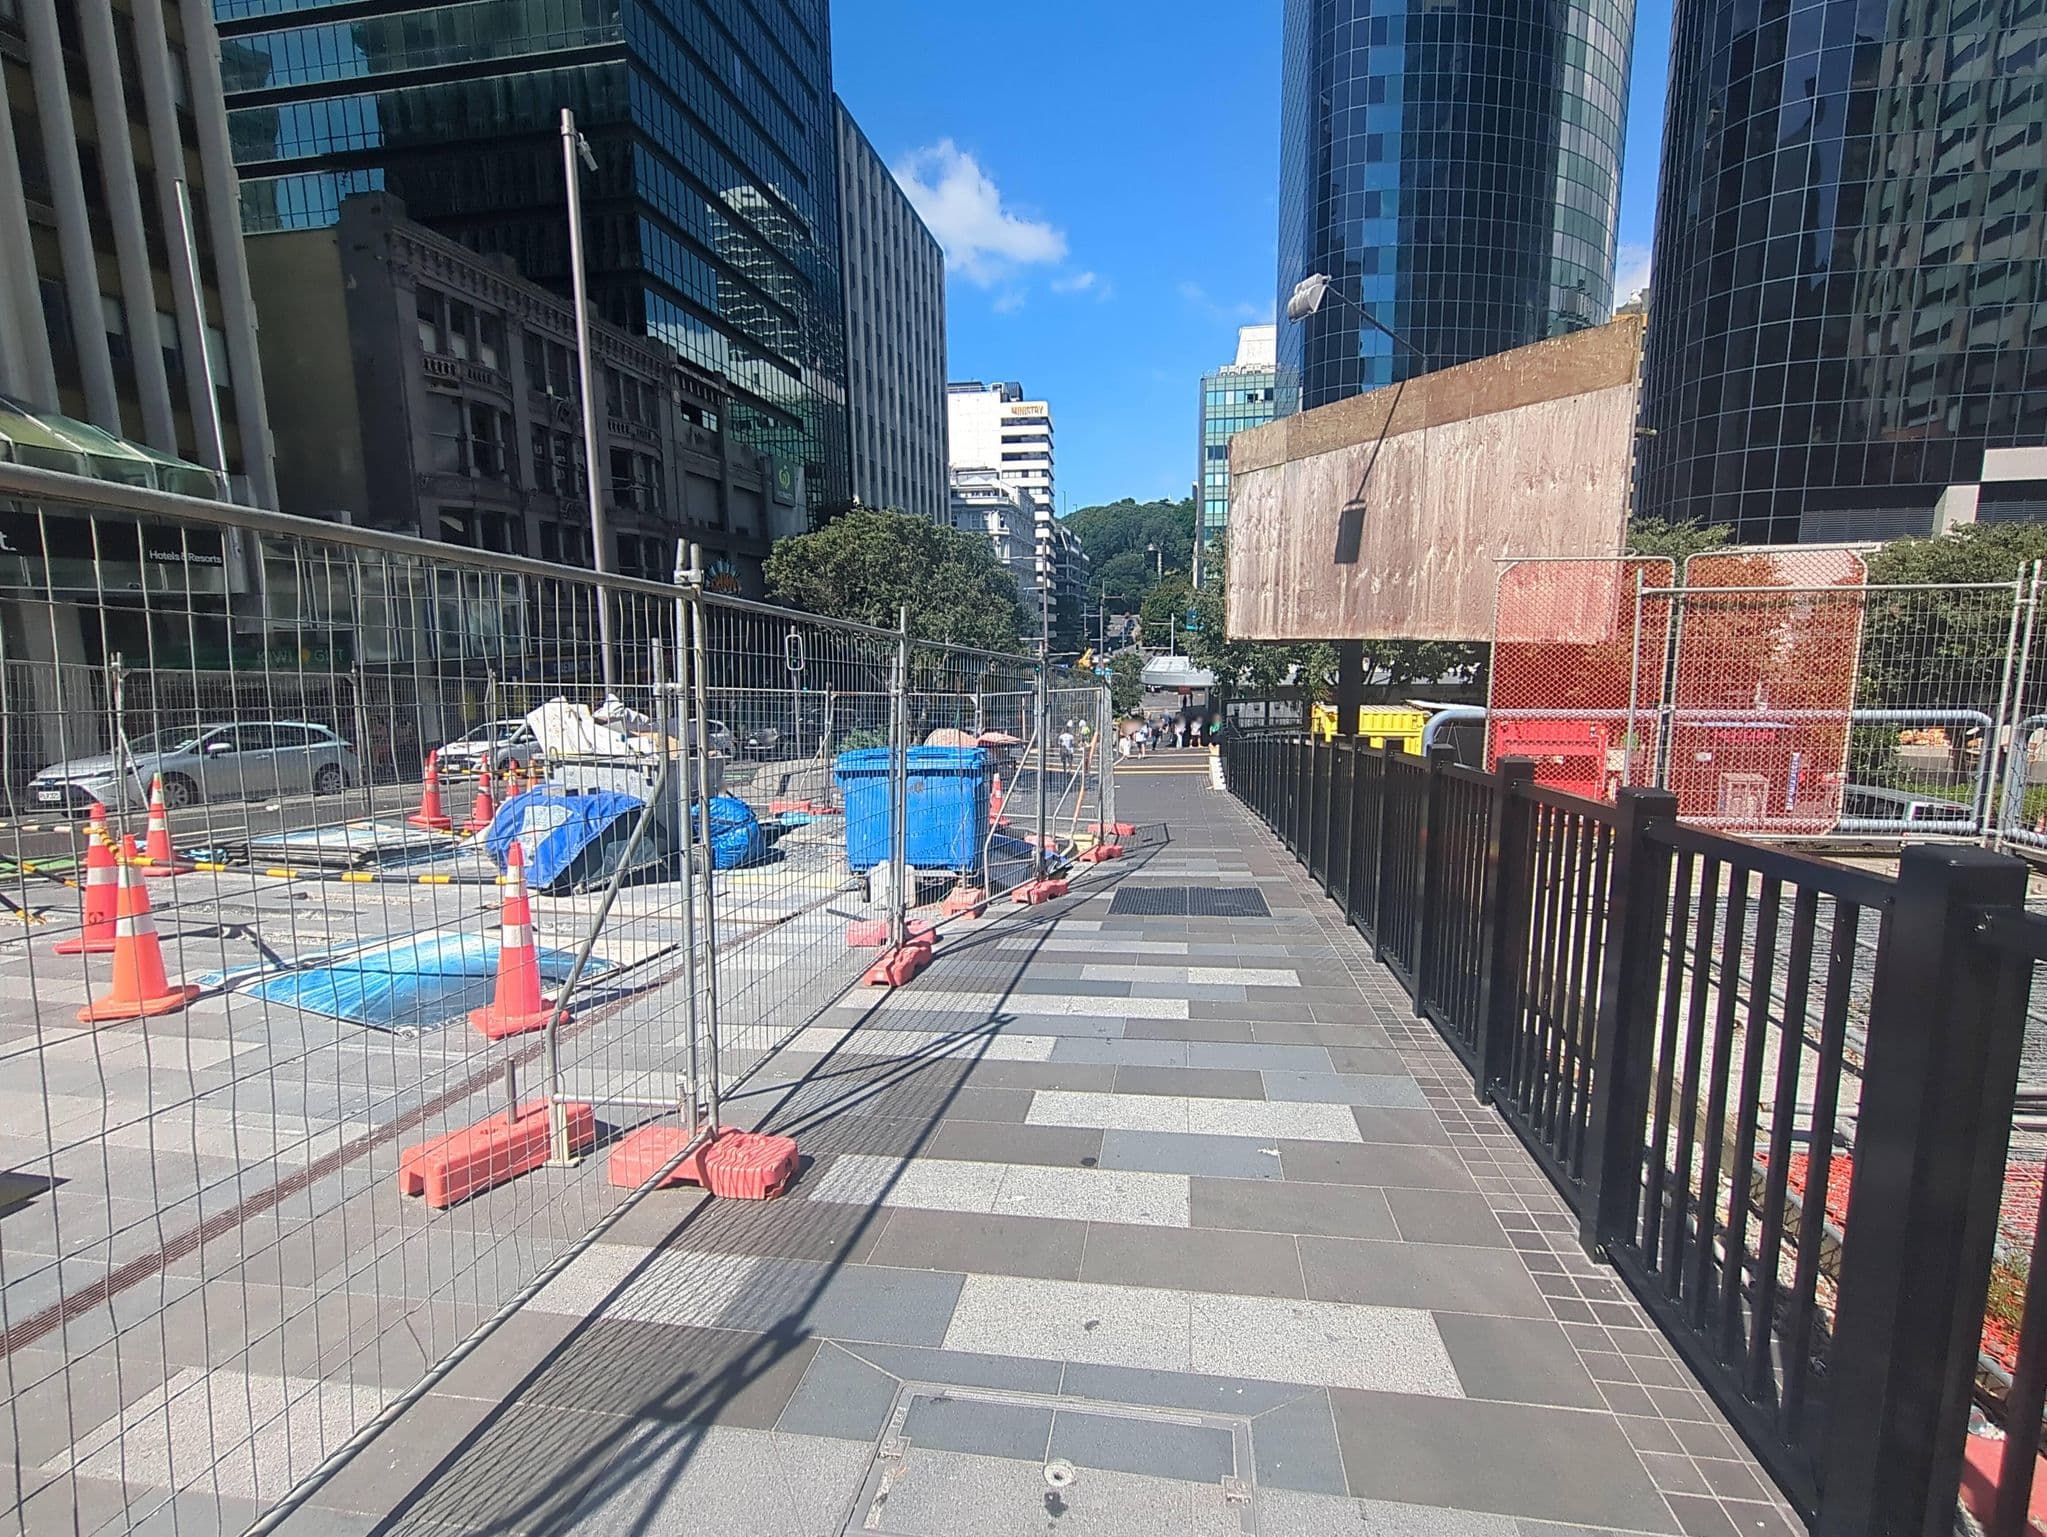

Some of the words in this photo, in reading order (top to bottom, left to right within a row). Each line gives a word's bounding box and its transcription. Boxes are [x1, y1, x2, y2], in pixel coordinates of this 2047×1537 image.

[149, 550, 180, 561] Hotels
[188, 552, 222, 564] Resorts
[256, 649, 293, 665] KIWI
